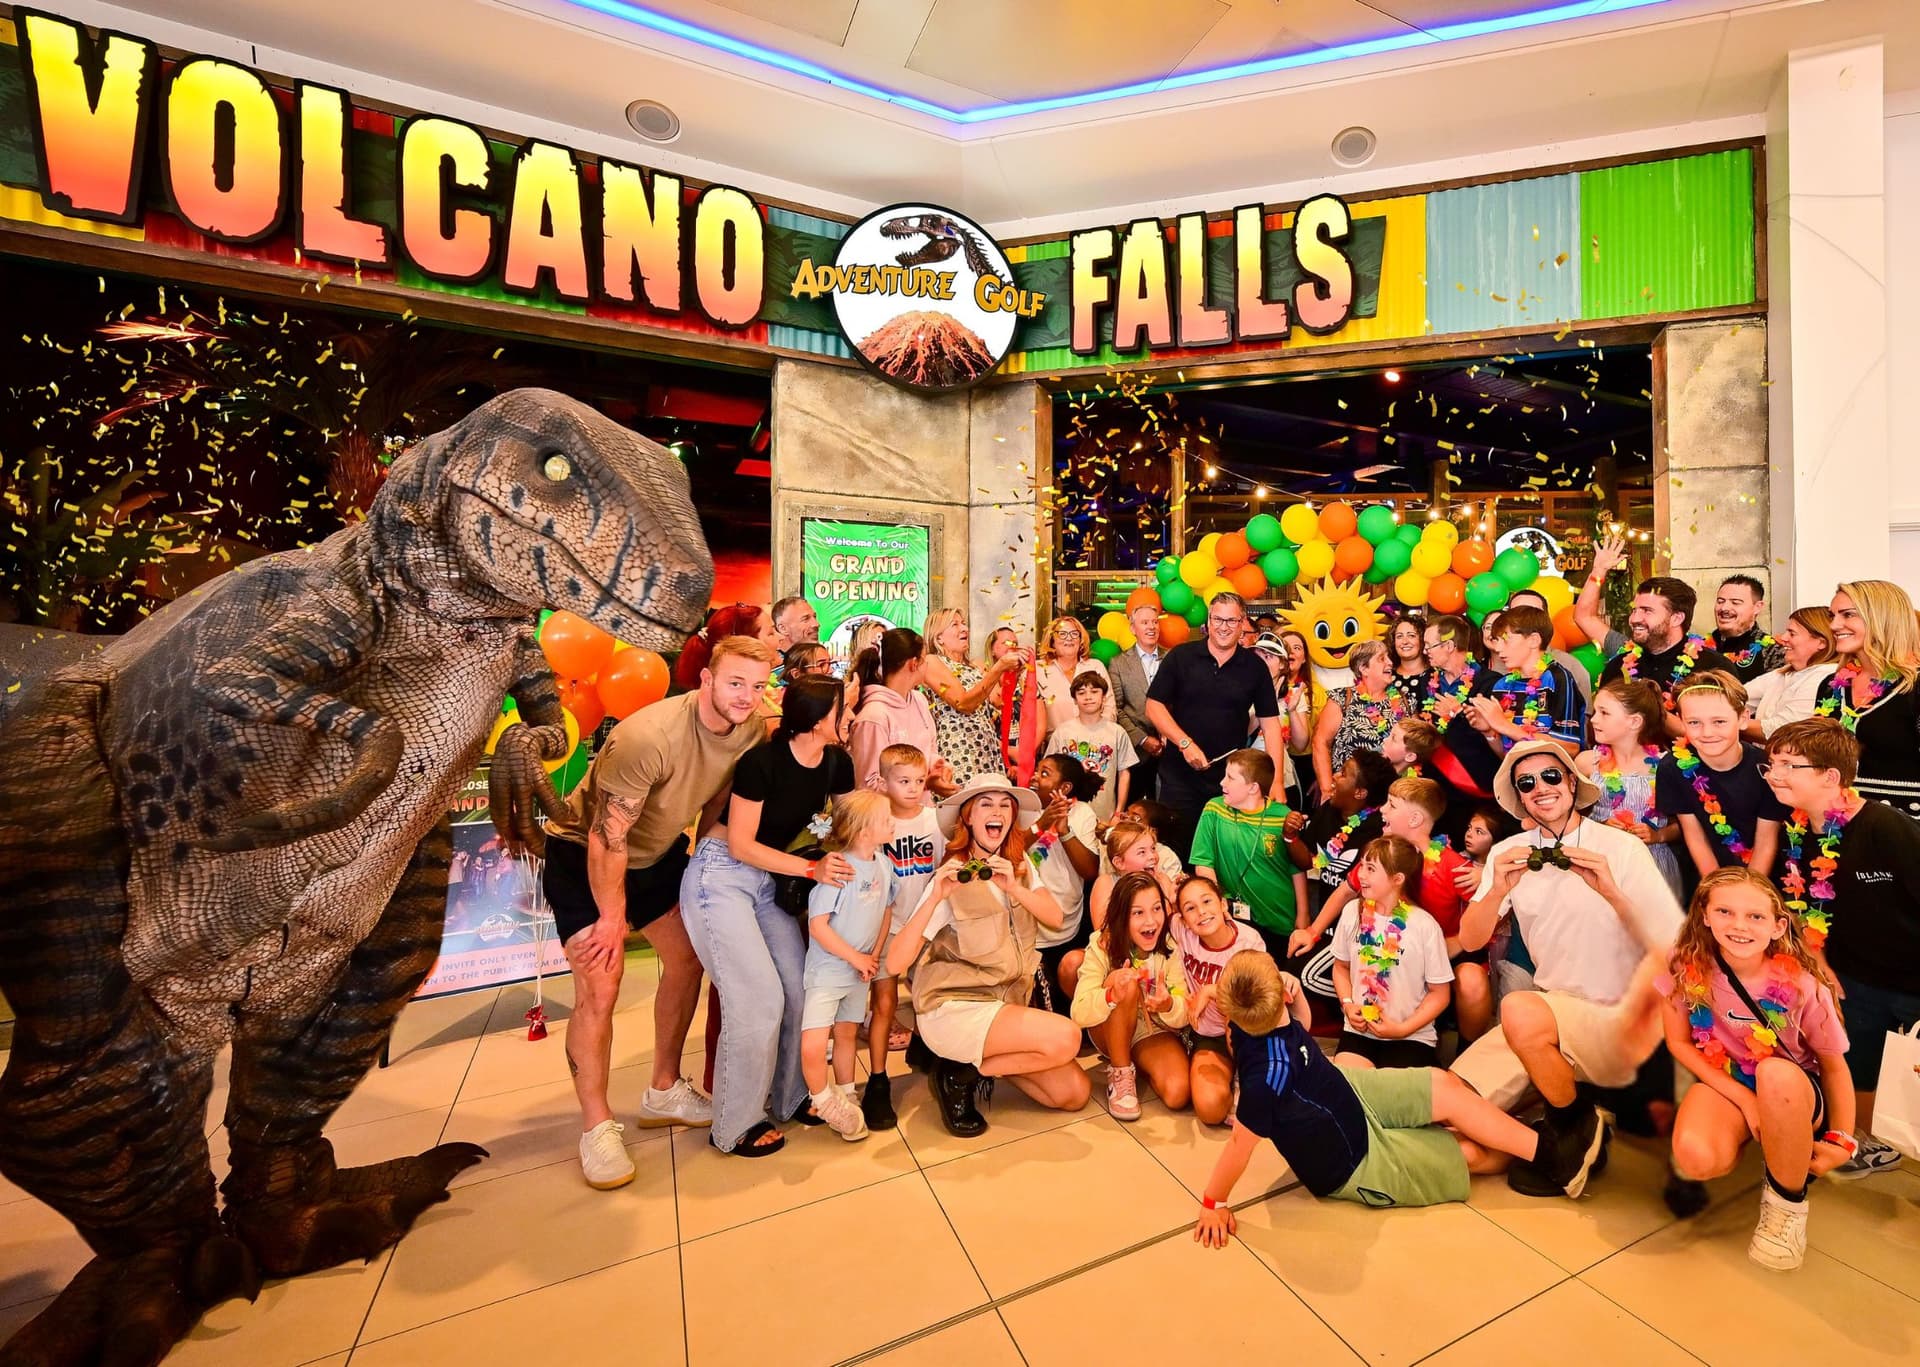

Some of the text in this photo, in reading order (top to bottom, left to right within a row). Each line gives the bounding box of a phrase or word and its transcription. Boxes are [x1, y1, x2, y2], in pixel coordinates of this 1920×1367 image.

[15, 8, 767, 330] VOLCANO
[1069, 193, 1355, 354] FALLS
[790, 257, 1047, 318] ADVENTURE GOLF
[825, 536, 910, 550] Welcome To Our
[830, 553, 905, 576] GRAND
[1555, 553, 1587, 572] GOLF
[814, 579, 919, 602] OPENING
[451, 796, 489, 812] AND
[883, 834, 934, 860] Nike
[442, 951, 536, 972] INVITE ONLY EVEN
[442, 974, 457, 983] TO
[461, 971, 480, 981] THE
